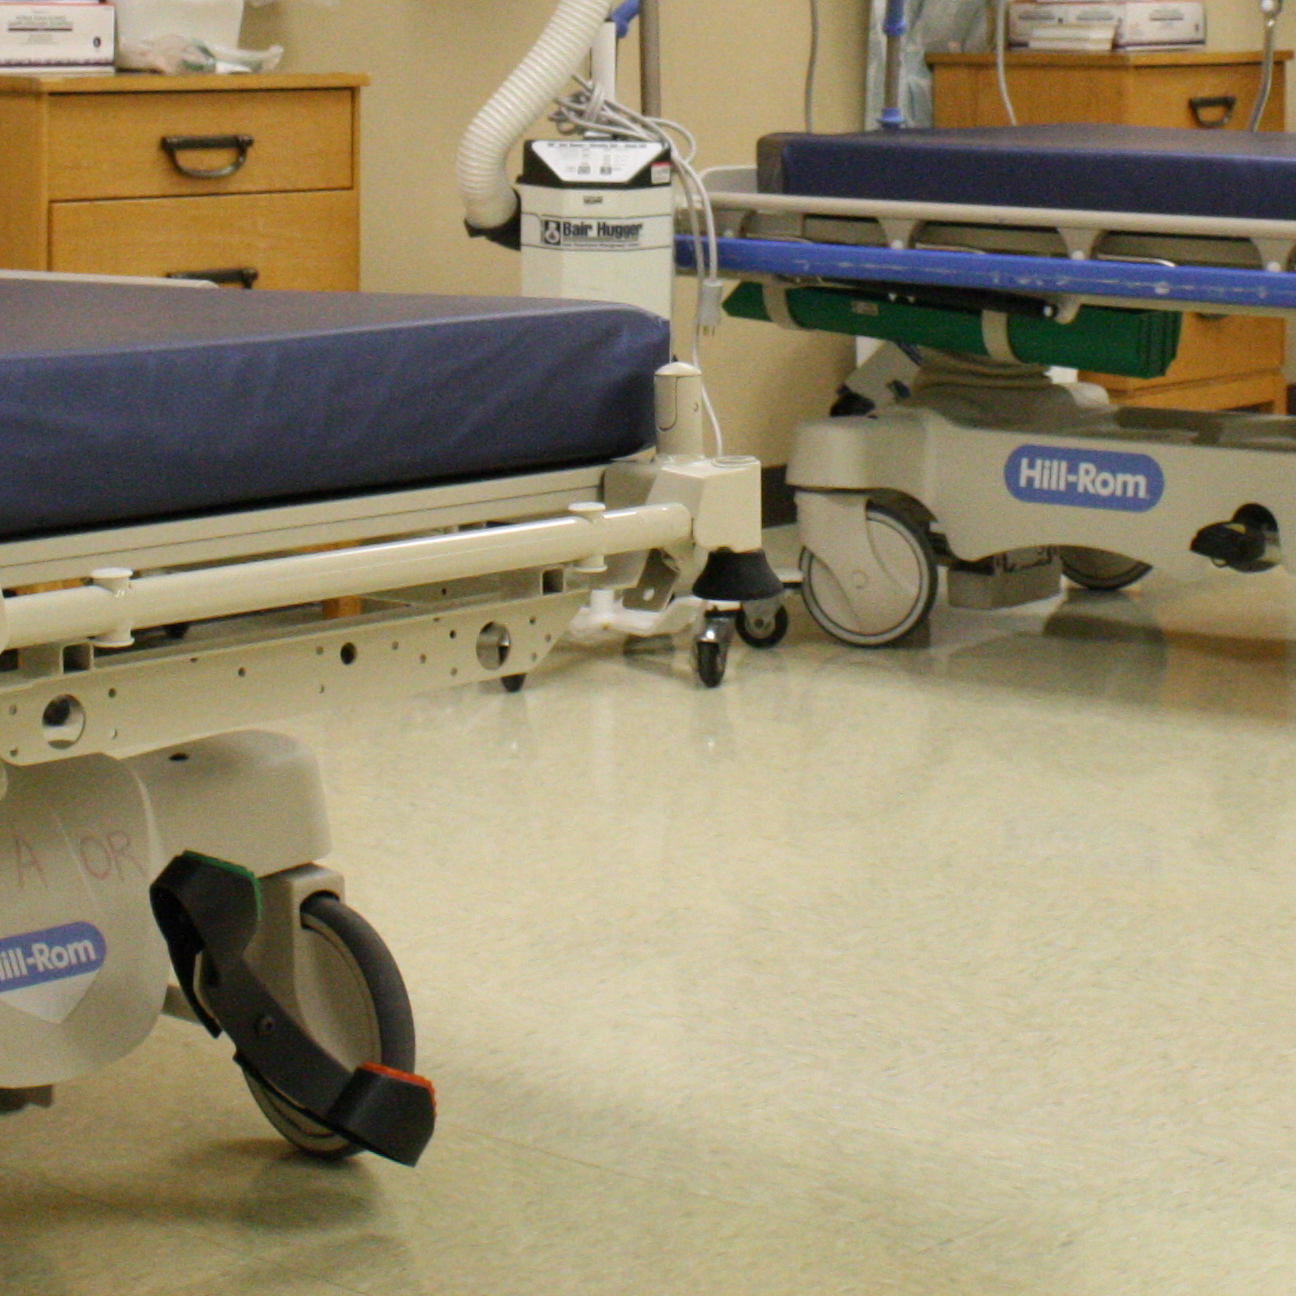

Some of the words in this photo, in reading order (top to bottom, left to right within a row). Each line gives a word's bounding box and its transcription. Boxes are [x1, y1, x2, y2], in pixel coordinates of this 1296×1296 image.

[562, 221, 593, 237] Bair
[597, 221, 643, 240] Hugger
[1019, 456, 1148, 499] Hill-Rom
